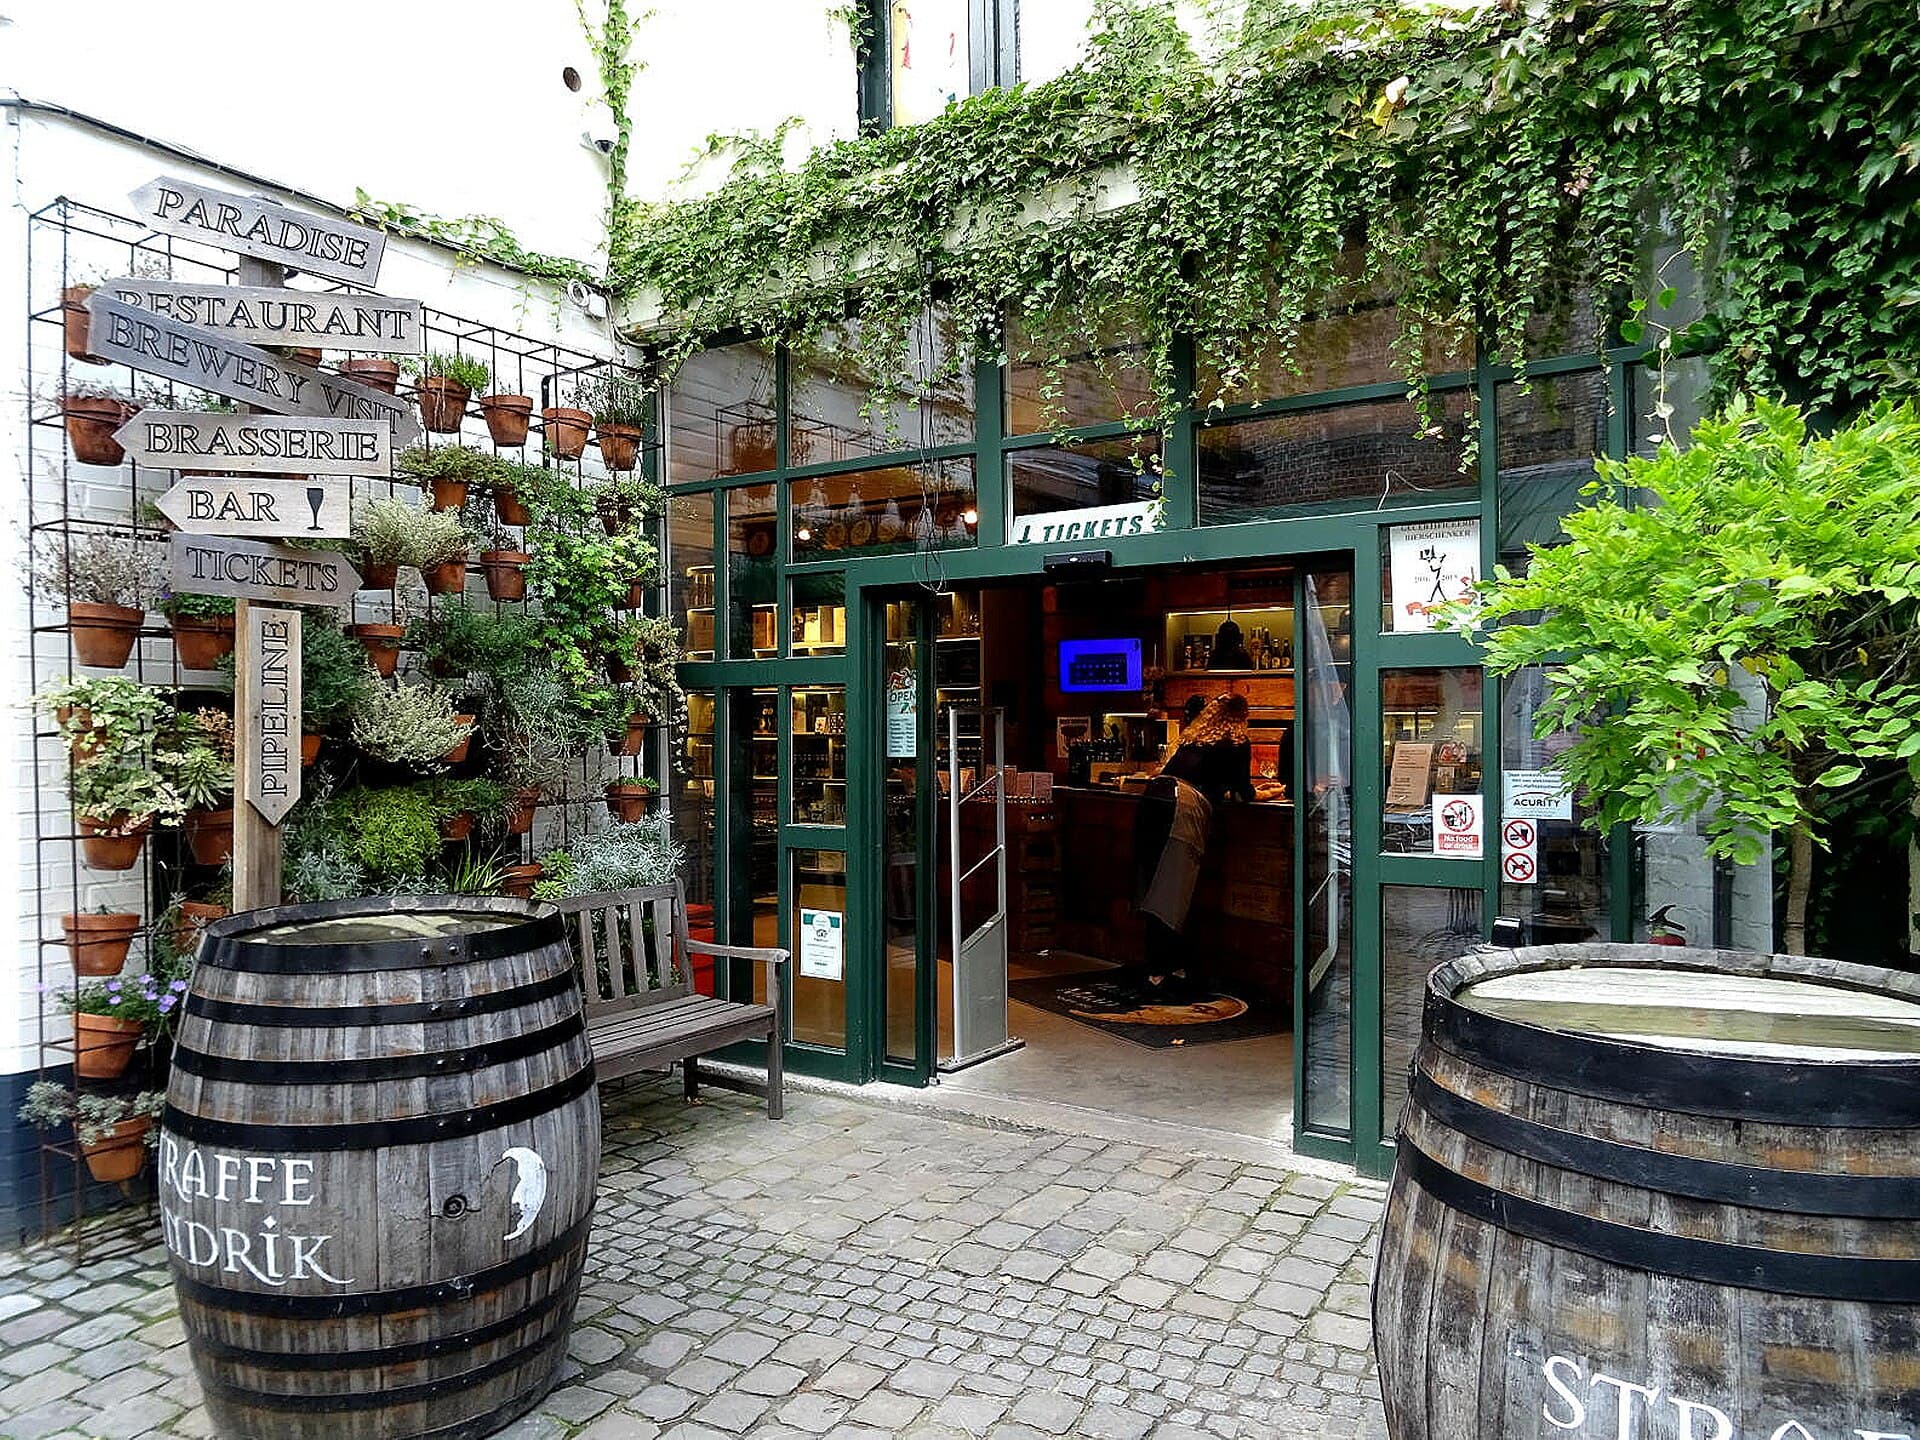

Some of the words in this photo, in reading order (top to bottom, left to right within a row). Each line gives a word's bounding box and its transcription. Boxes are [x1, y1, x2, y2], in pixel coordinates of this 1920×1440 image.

[153, 187, 370, 270] PARADISE
[106, 311, 310, 403] BREWERY
[320, 383, 404, 434] VISIT
[145, 423, 380, 462] BRASSERIE
[186, 489, 280, 523] BAR
[1042, 515, 1144, 542] TICKETS
[186, 547, 340, 592] TICKETS
[262, 621, 290, 798] PIPELINE
[889, 690, 916, 703] OPEN
[1513, 799, 1560, 808] ACURITY
[161, 1132, 315, 1207] RAFFE
[1542, 1355, 1912, 1440] STR
